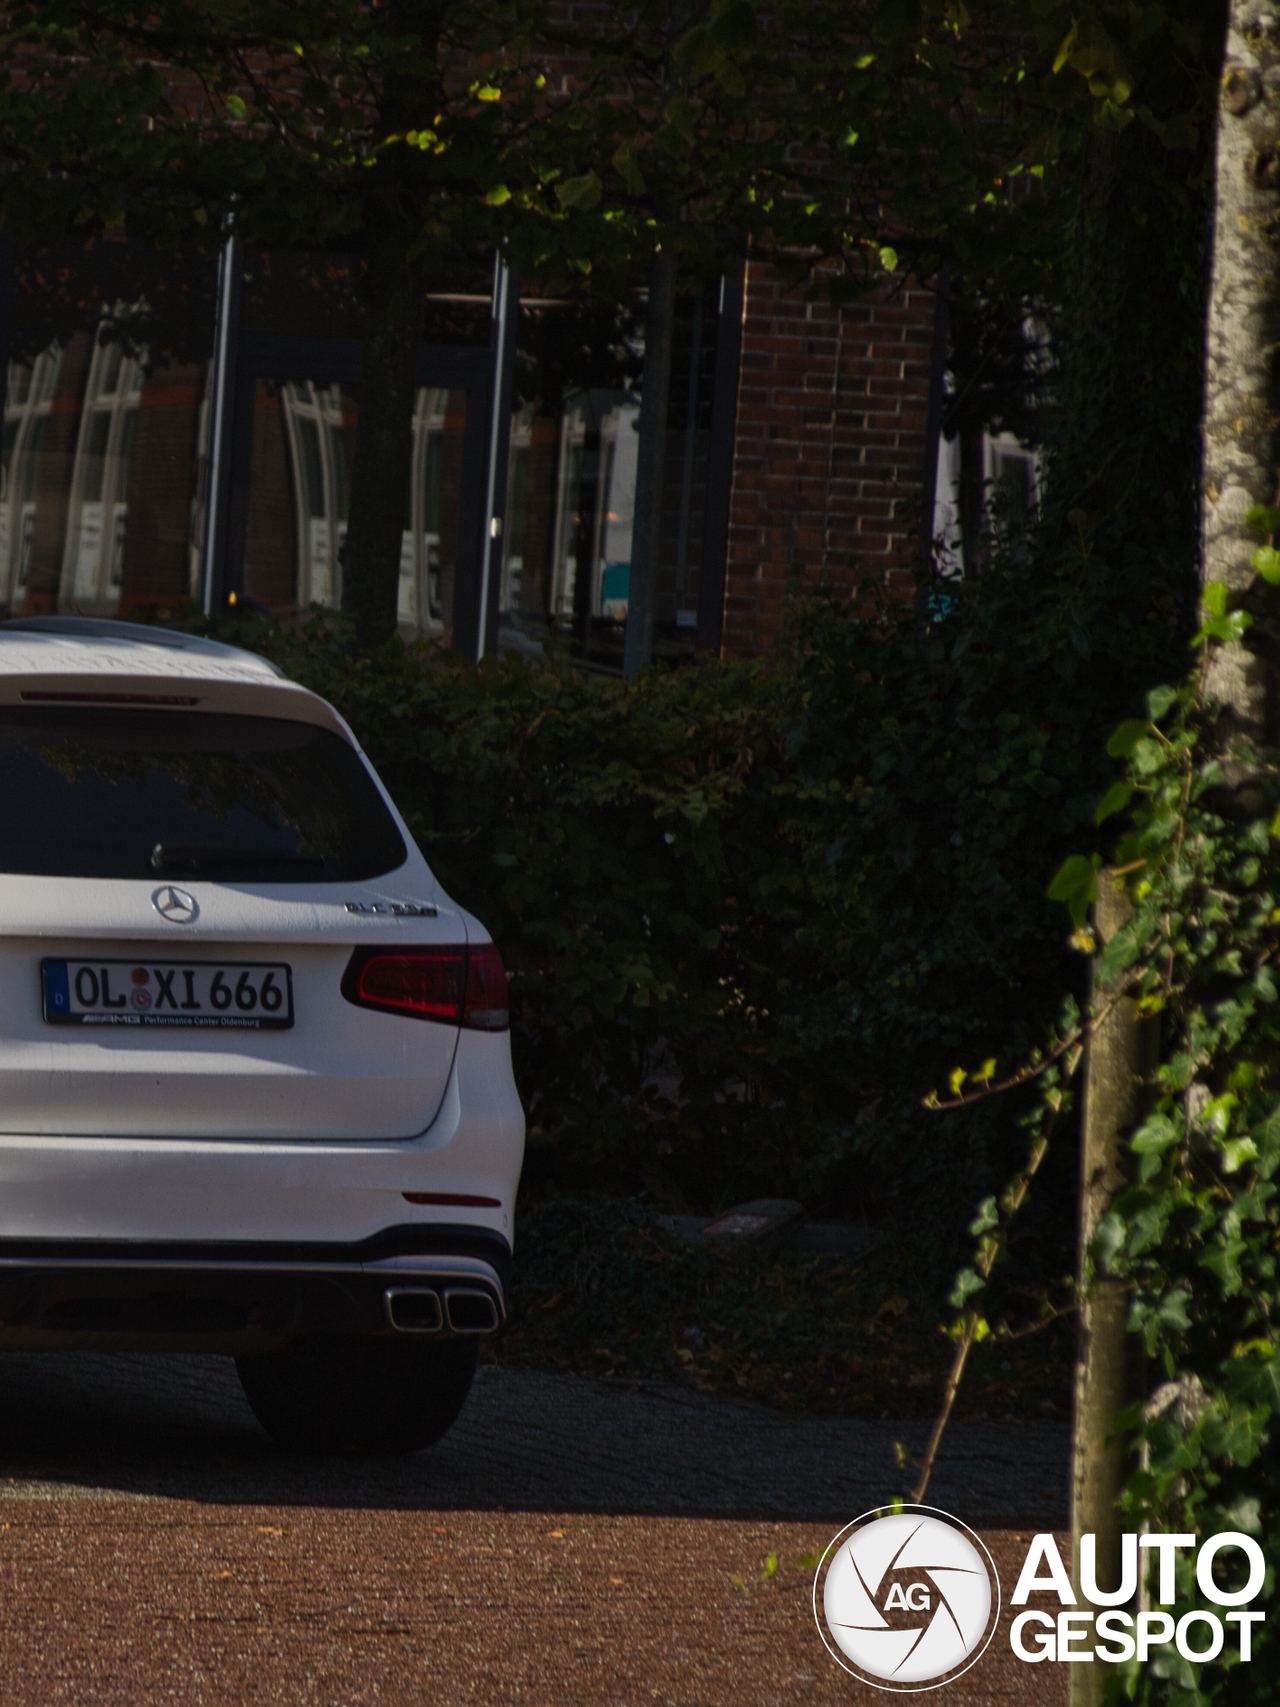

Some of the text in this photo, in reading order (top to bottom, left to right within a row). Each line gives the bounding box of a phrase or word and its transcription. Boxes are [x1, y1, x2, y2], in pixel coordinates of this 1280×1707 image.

[75, 967, 282, 1011] OL XI 666
[54, 992, 63, 1005] D
[144, 1015, 193, 1026] Performance
[194, 1017, 219, 1026] Center
[221, 1018, 260, 1029] Oldenburg
